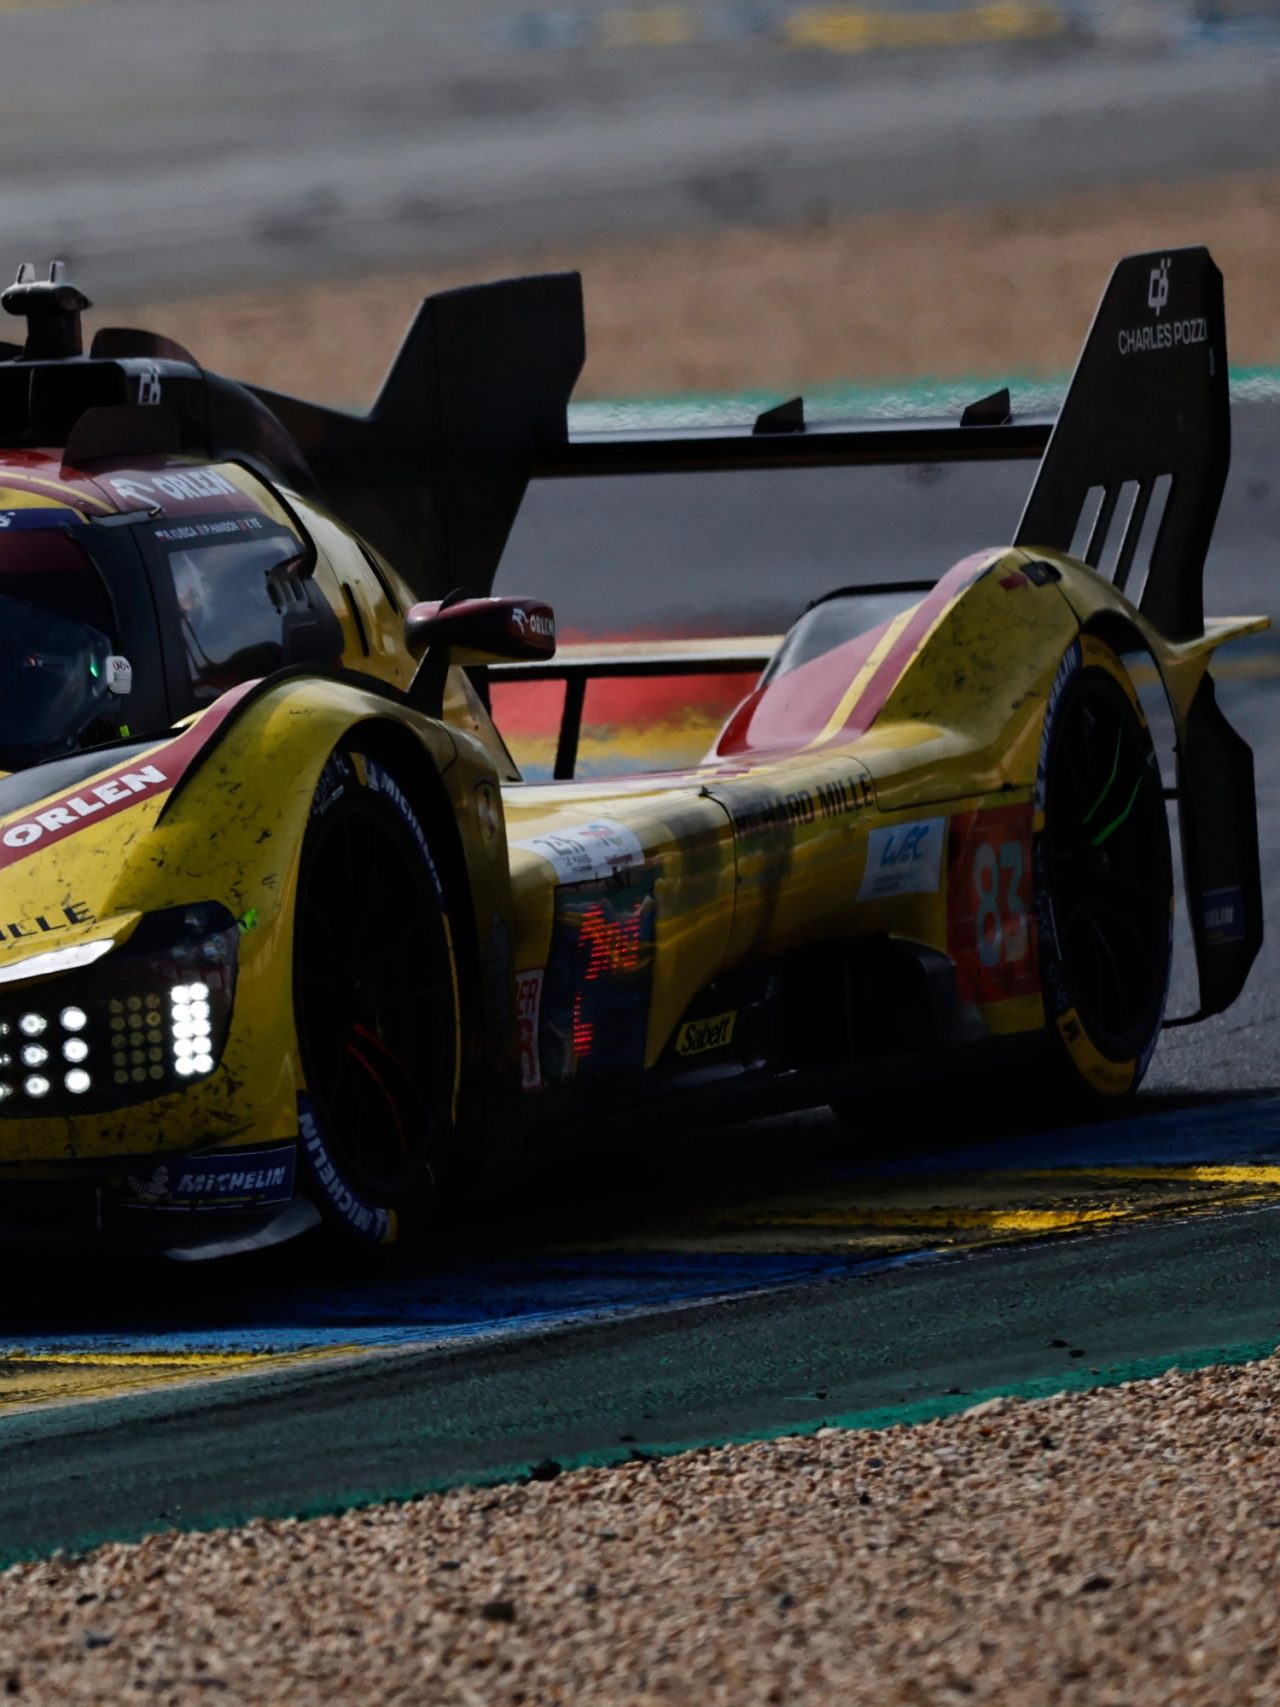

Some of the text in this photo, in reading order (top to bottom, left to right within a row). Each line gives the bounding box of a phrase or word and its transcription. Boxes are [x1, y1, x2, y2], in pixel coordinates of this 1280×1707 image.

[1118, 318, 1207, 354] CHARLES POZZI
[151, 468, 237, 500] ORLEN
[530, 614, 555, 636] ORLEN
[3, 764, 167, 848] ORLEN
[816, 773, 873, 819] MILLE
[973, 840, 1029, 967] 83
[177, 1166, 286, 1193] MICHELIN
[298, 1111, 373, 1232] MICHELIN
